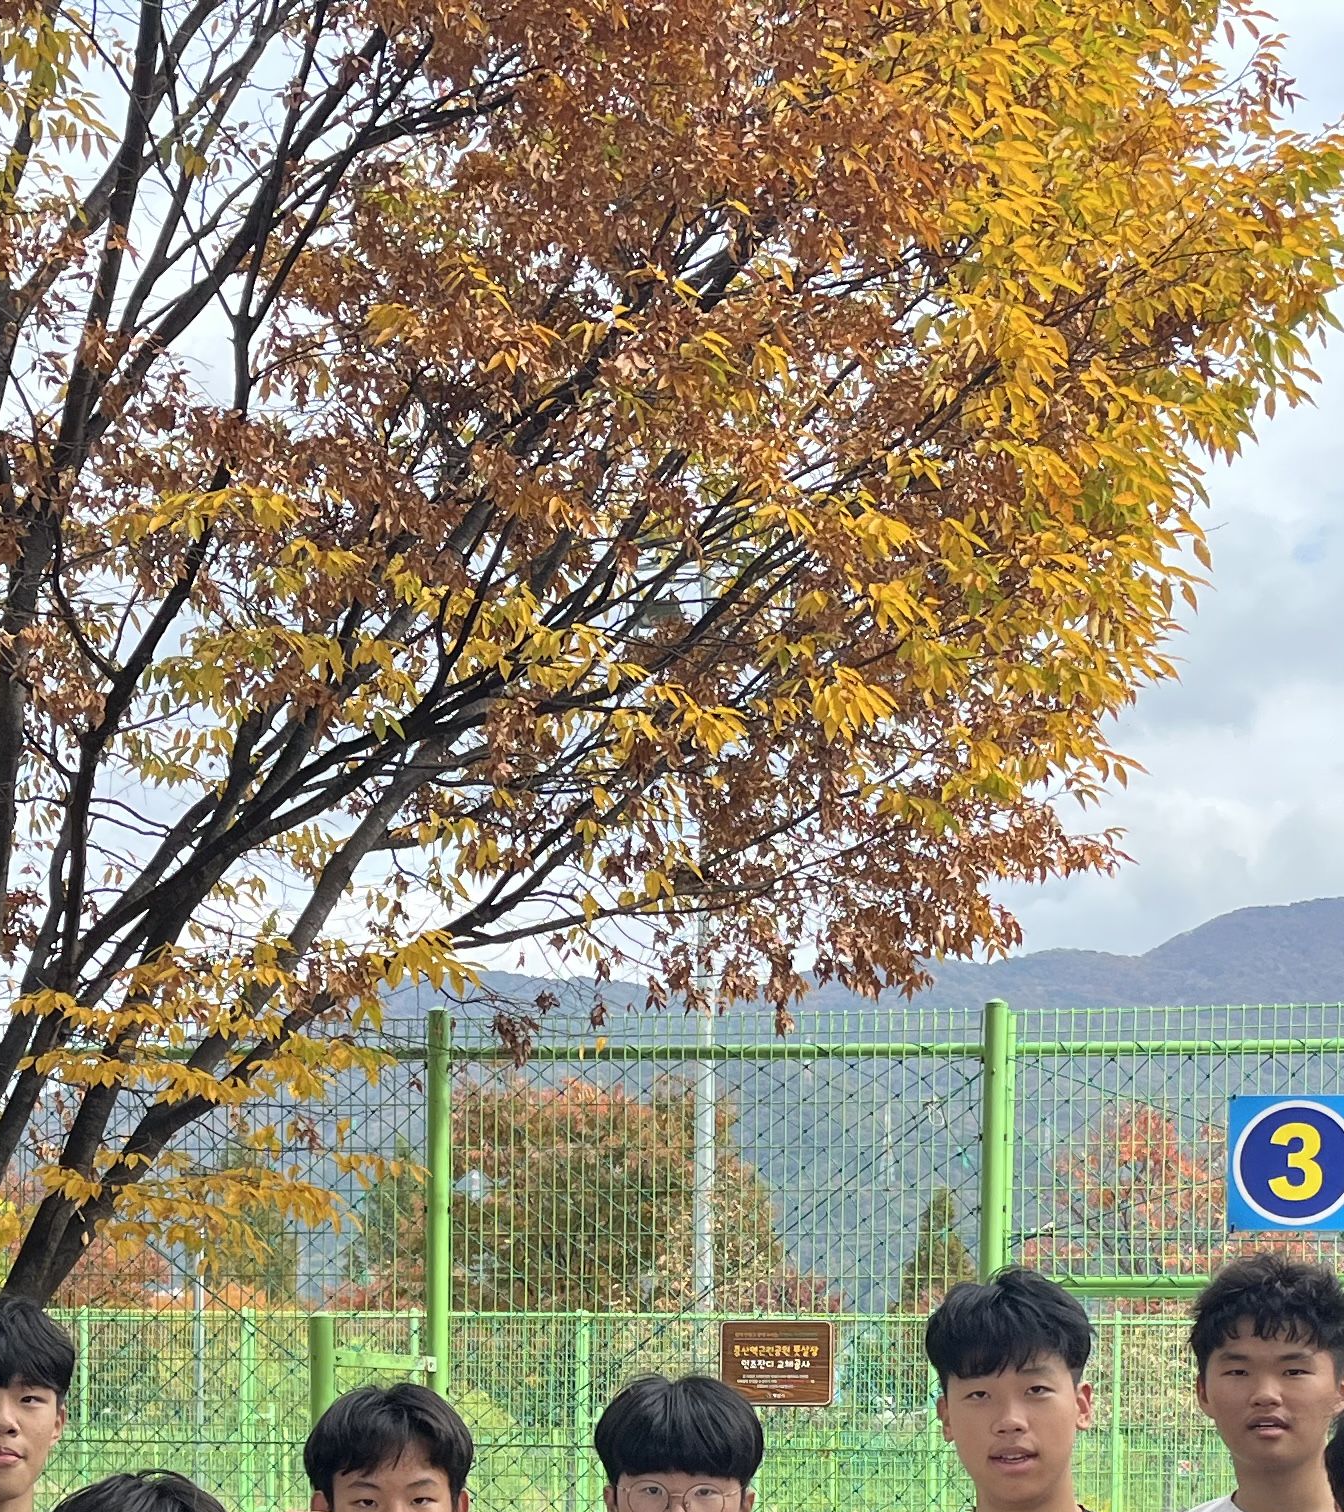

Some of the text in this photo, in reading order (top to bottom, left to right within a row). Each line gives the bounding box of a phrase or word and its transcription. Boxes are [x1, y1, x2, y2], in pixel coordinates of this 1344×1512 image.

[1267, 1122, 1323, 1201] 3
[740, 1358, 811, 1370] 인조잔디 교체공사
